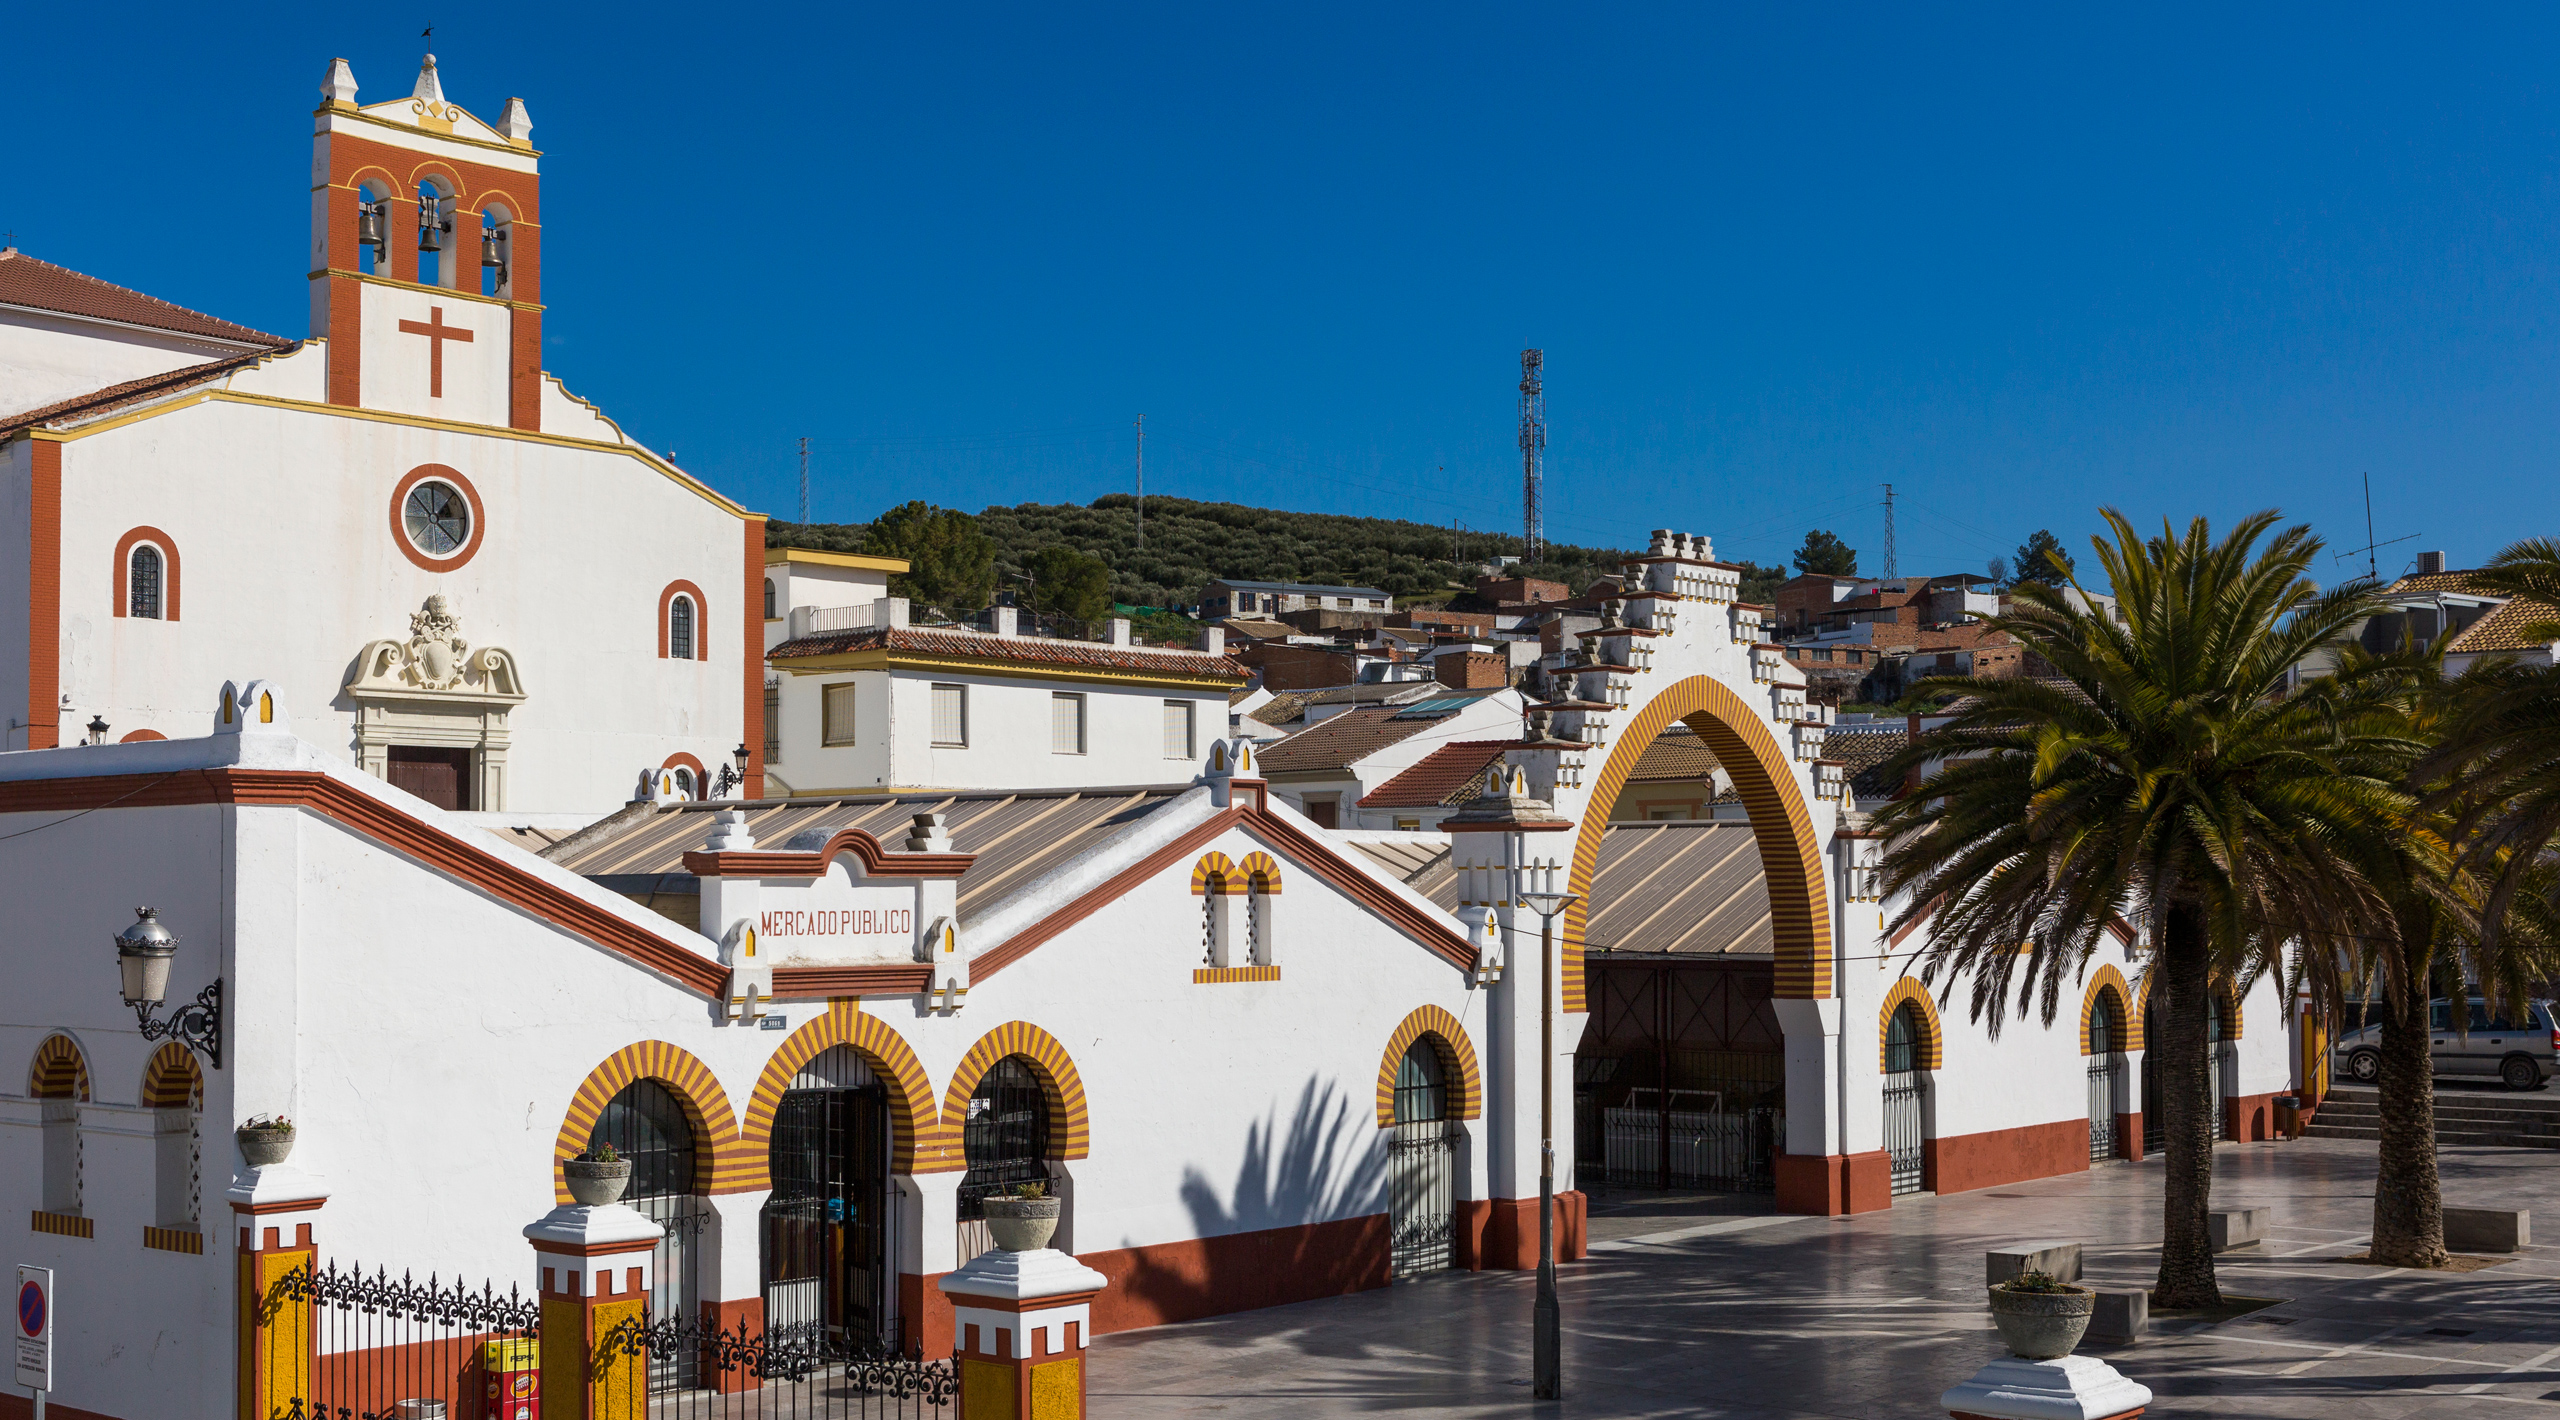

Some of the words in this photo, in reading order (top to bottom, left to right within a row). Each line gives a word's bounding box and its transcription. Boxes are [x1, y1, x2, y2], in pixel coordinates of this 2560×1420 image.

[761, 911, 837, 936] MERCADO
[841, 910, 910, 935] PUBLICO
[510, 1354, 534, 1362] PEPSI
